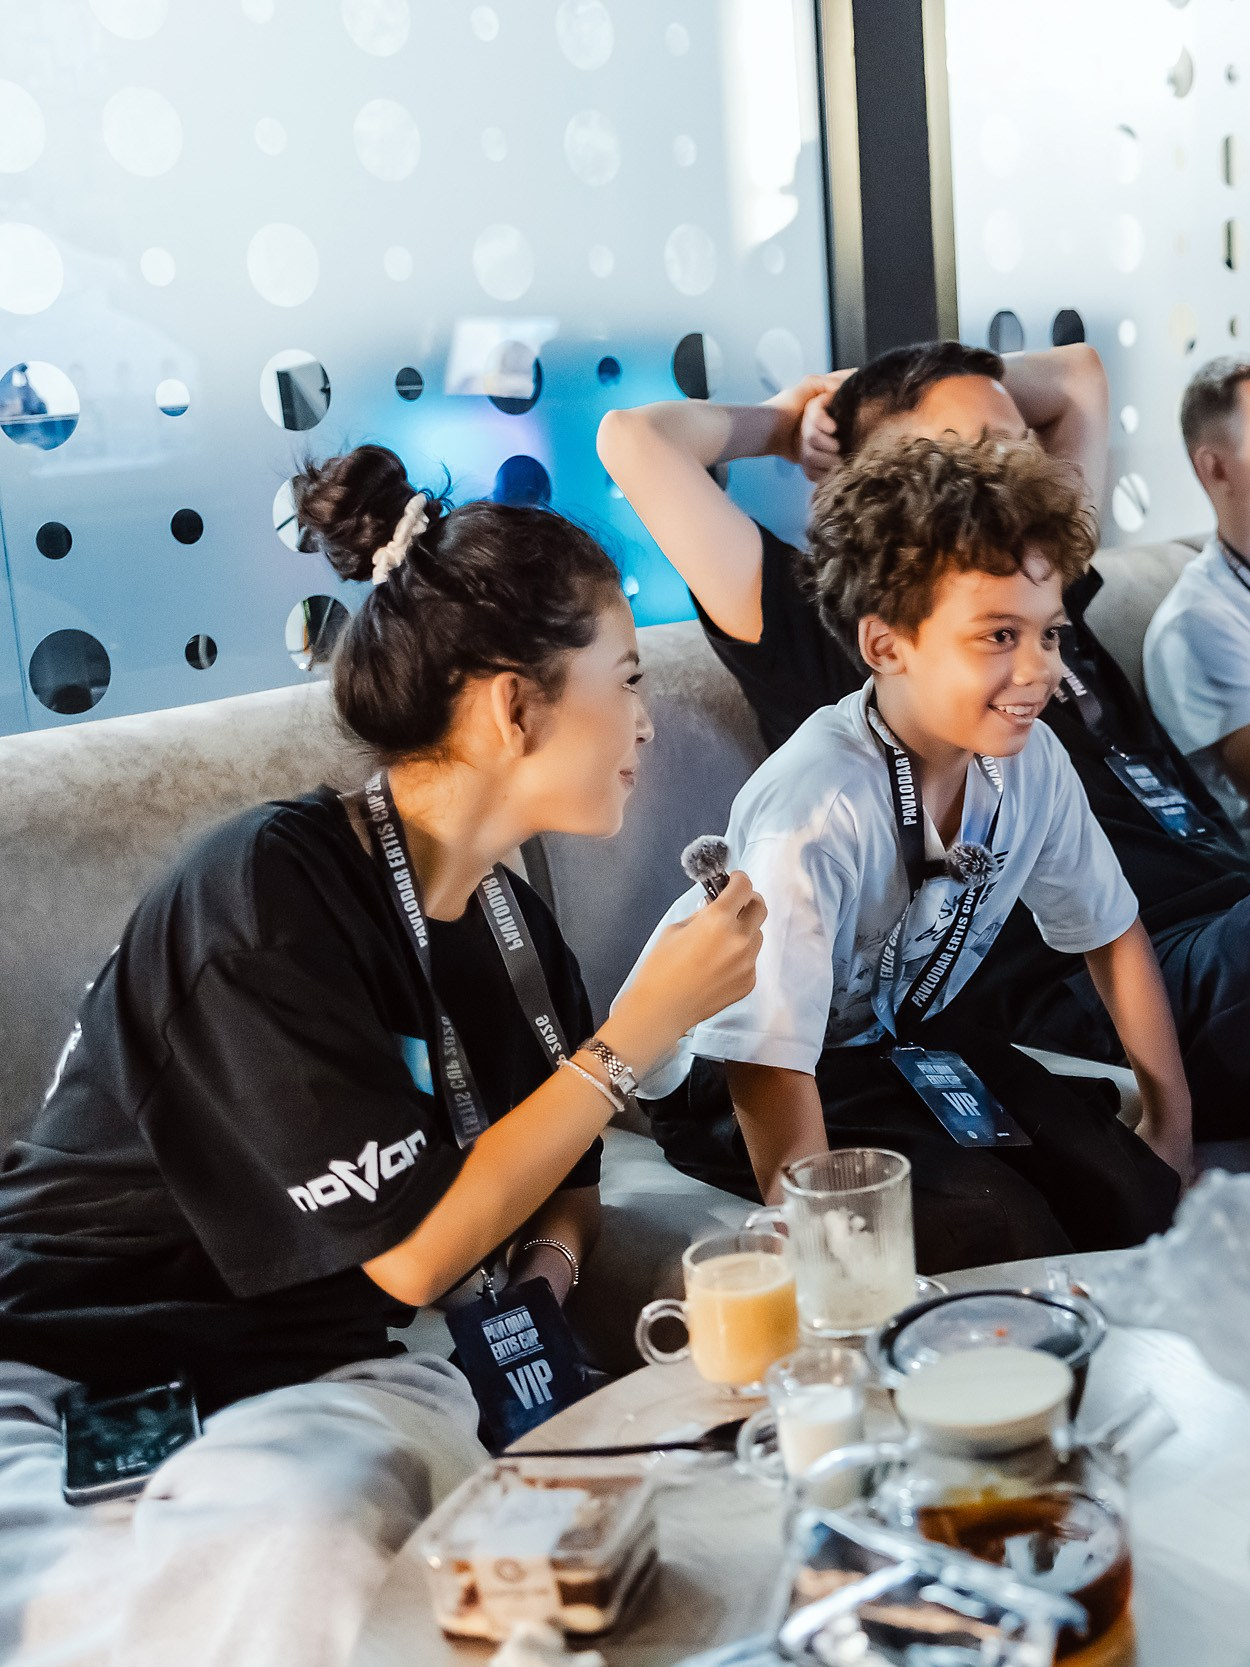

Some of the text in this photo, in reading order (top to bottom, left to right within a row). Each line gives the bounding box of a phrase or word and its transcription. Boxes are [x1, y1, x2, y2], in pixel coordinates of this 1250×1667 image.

[367, 795, 389, 822] CUP
[894, 755, 918, 826] PAVLODAR
[377, 822, 406, 868] ERTIS
[393, 868, 428, 948] PAVLODAR
[911, 952, 954, 1008] PAVLODAR
[946, 916, 968, 952] ERTIS
[942, 1092, 981, 1116] VIP
[482, 1310, 535, 1343] PAVLODAR
[490, 1328, 540, 1361] ERTIS CUP
[505, 1358, 554, 1410] VIP
